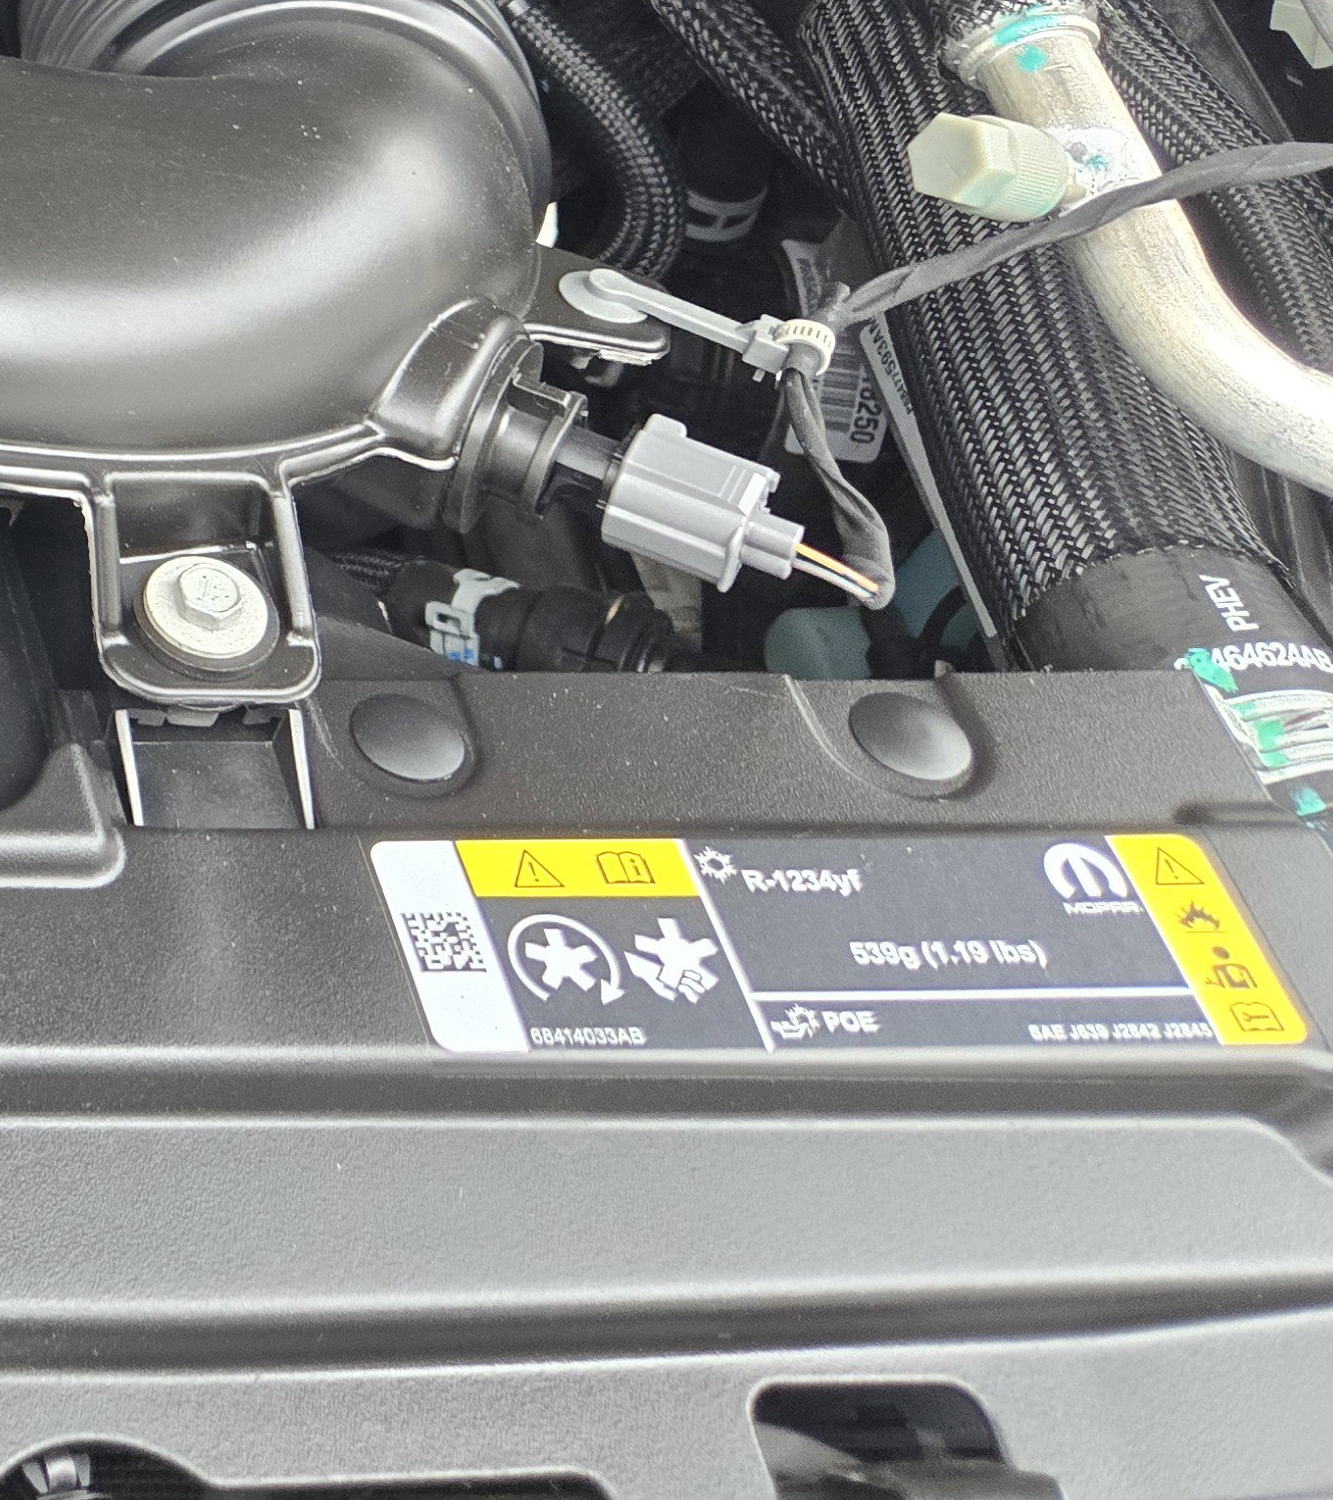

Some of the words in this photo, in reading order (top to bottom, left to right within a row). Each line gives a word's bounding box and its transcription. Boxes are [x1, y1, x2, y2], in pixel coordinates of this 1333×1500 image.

[1198, 574, 1259, 632] PHEV
[743, 868, 864, 897] R-1234yf
[849, 940, 920, 969] 539g
[924, 939, 989, 969] (1.19
[993, 937, 1049, 969] lbs)
[823, 1010, 879, 1034] POE
[1028, 1023, 1067, 1041] SAE
